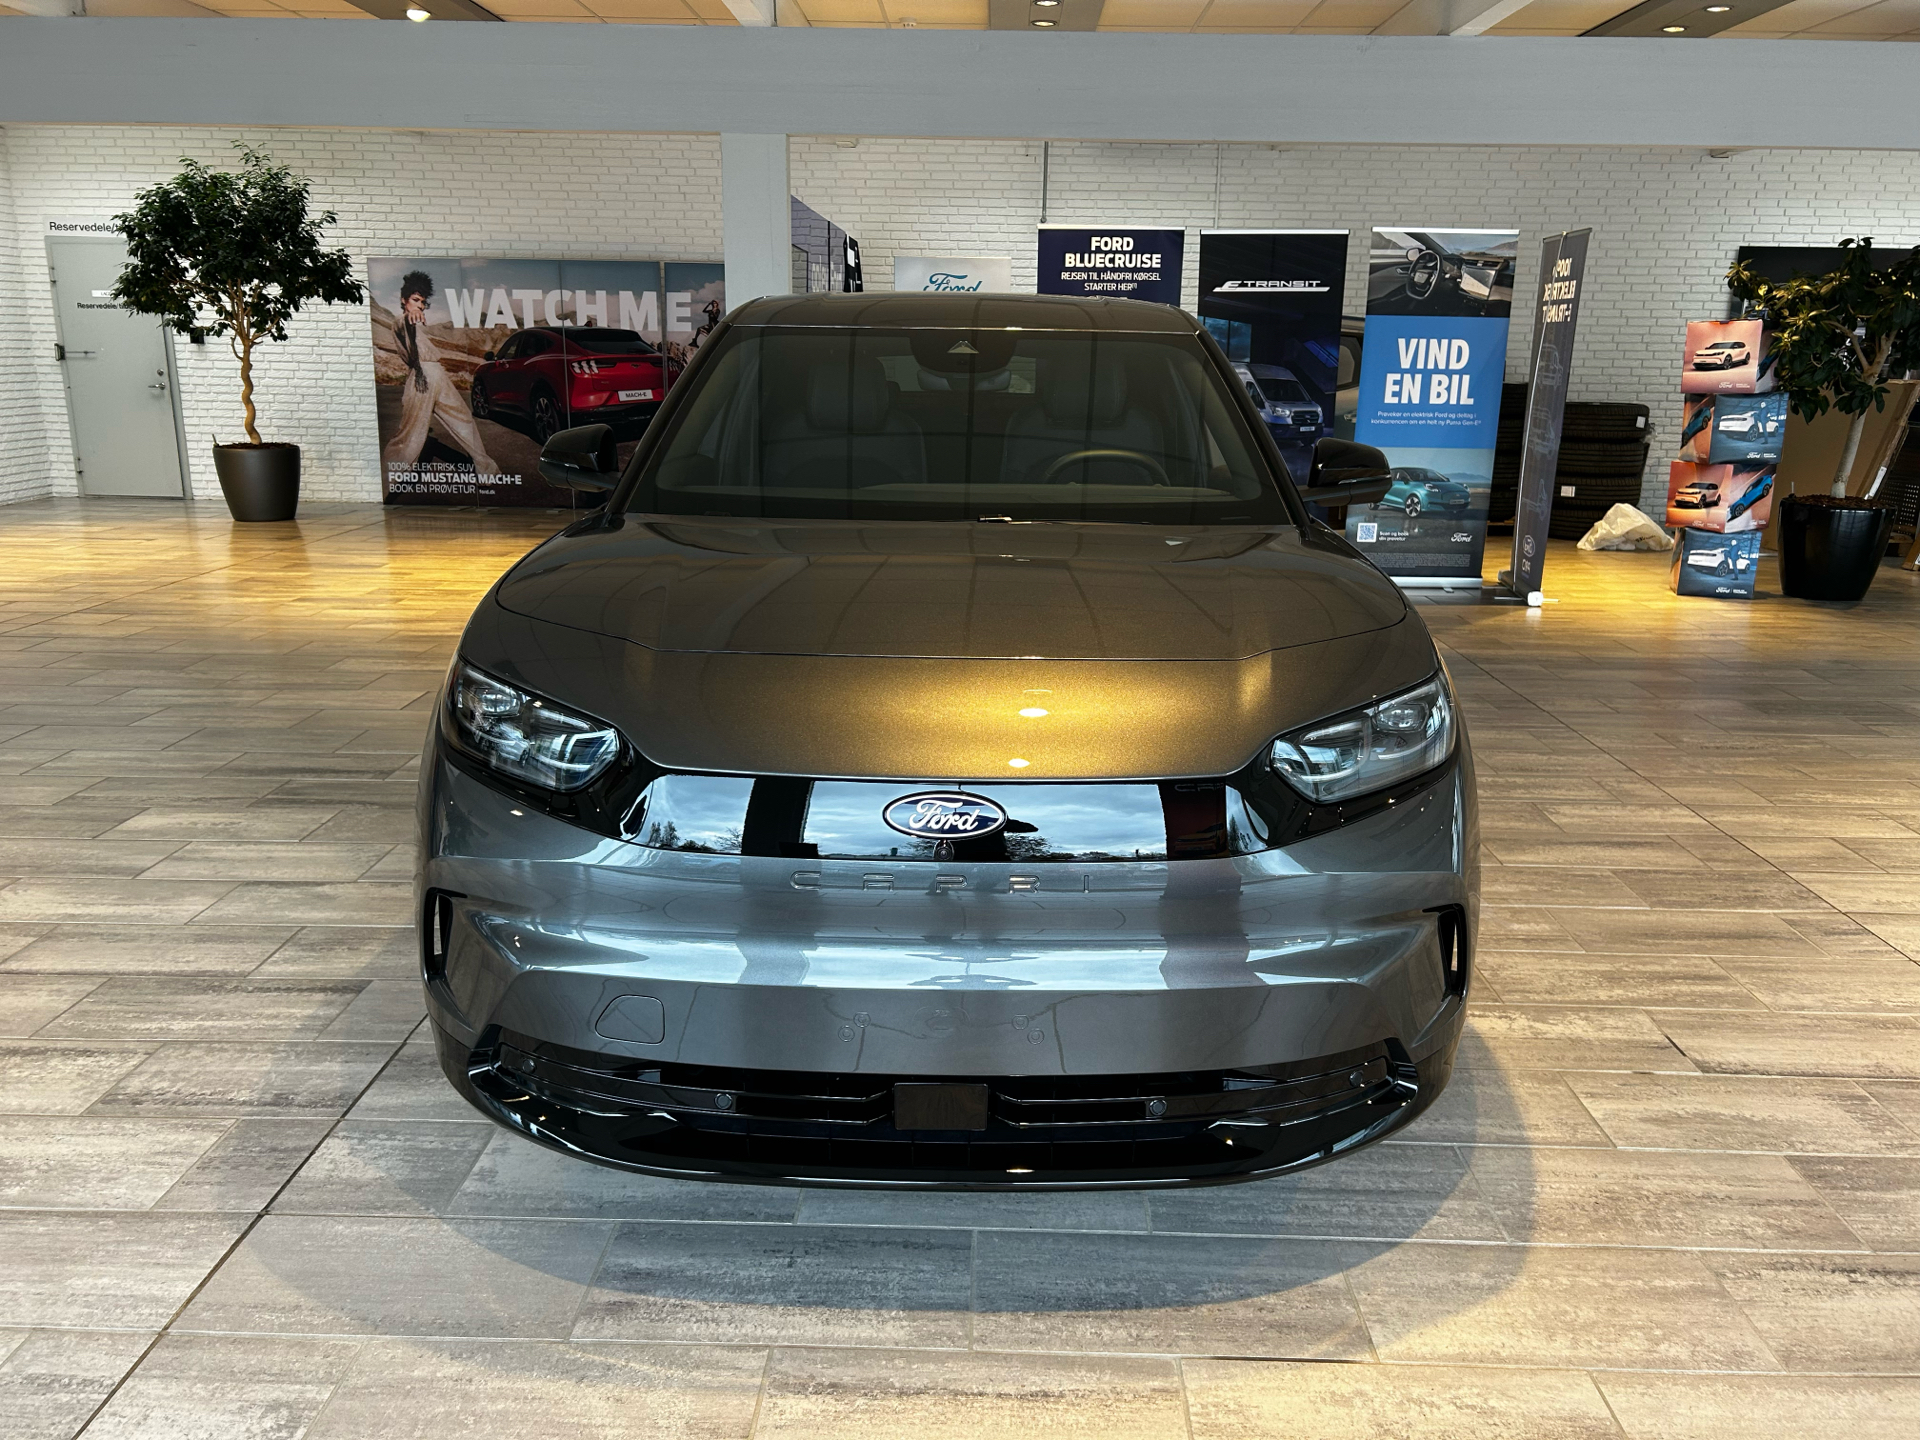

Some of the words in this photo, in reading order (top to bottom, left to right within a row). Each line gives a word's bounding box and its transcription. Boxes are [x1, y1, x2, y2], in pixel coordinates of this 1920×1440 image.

[1090, 236, 1134, 251] FORD
[1064, 253, 1161, 269] BLUECRUISE
[1061, 271, 1087, 280] REJSEN
[1088, 271, 1099, 280] TIL
[1100, 270, 1132, 280] HÅNDFRI
[1133, 271, 1162, 281] KØRSEL
[1084, 282, 1116, 291] STARTER
[444, 288, 608, 330] WATCH
[618, 290, 693, 332] ME
[1397, 338, 1470, 370] VIND
[1384, 373, 1422, 404] EN
[1429, 373, 1474, 405] BIL
[387, 461, 411, 471] 100%
[412, 462, 456, 472] ELEKTRISK
[457, 463, 474, 472] SUV
[388, 472, 419, 482] FORD
[421, 472, 476, 484] MUSTANG
[477, 473, 522, 485] MACH-E
[389, 483, 414, 493] BOOK
[416, 484, 428, 493] EN
[429, 484, 476, 494] PRØVETUR
[1450, 532, 1472, 543] Ford
[908, 799, 981, 831] Ford
[790, 870, 1090, 894] CAPRI
